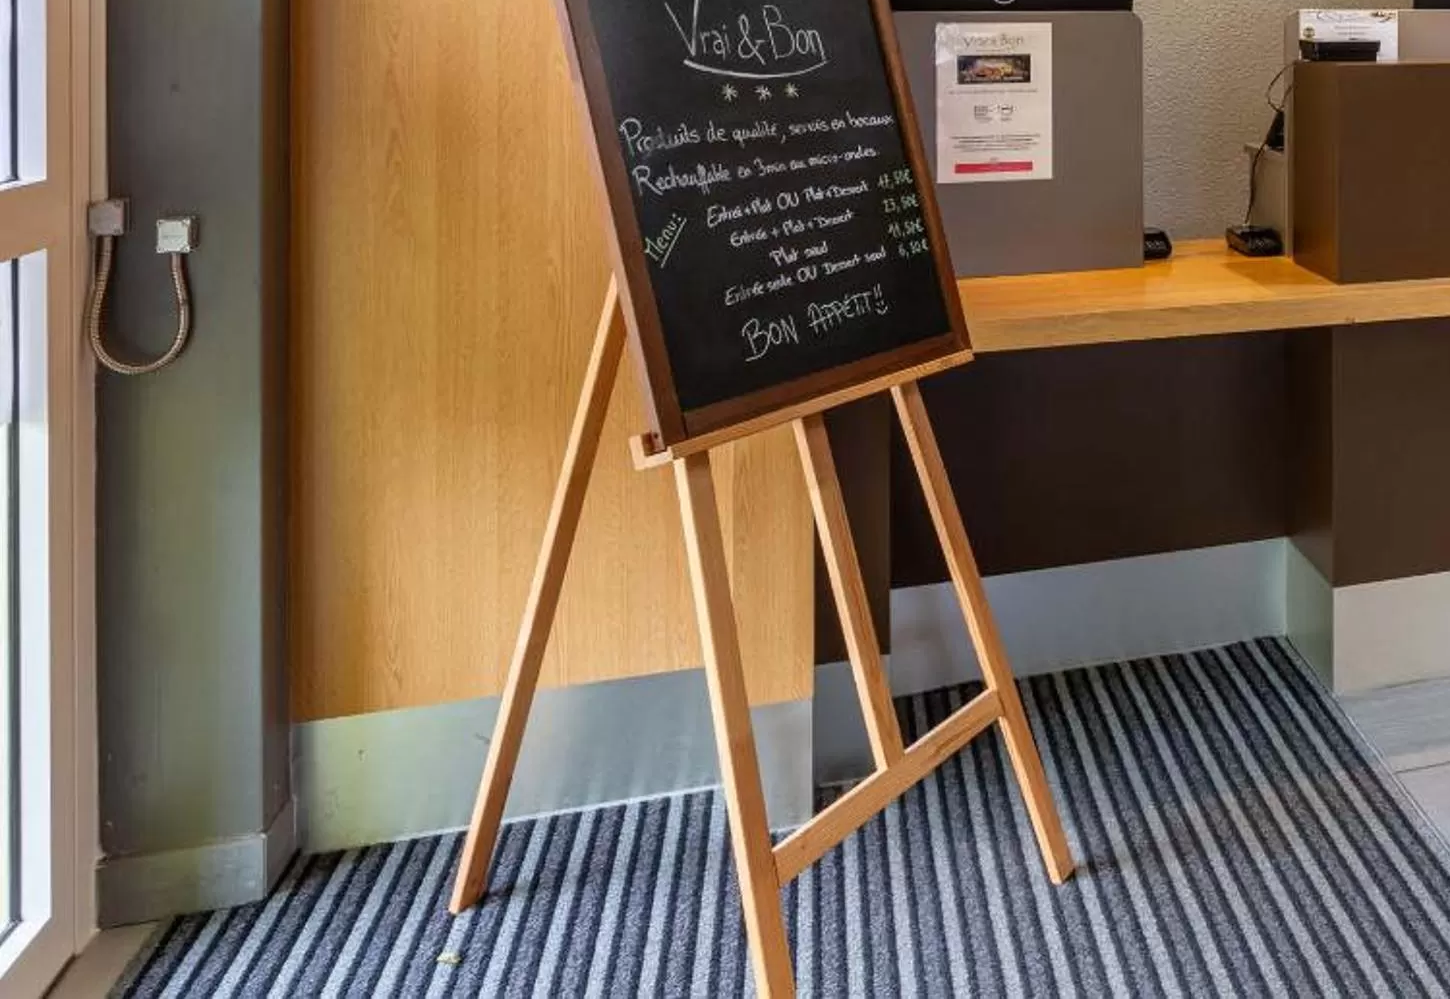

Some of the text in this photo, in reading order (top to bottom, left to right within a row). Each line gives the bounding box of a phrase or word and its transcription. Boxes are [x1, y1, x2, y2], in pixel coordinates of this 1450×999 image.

[619, 117, 700, 155] Produits
[706, 120, 729, 144] de
[846, 110, 894, 128] bocaux
[776, 191, 801, 210] OU
[796, 265, 818, 283] OU
[741, 314, 800, 362] BON
